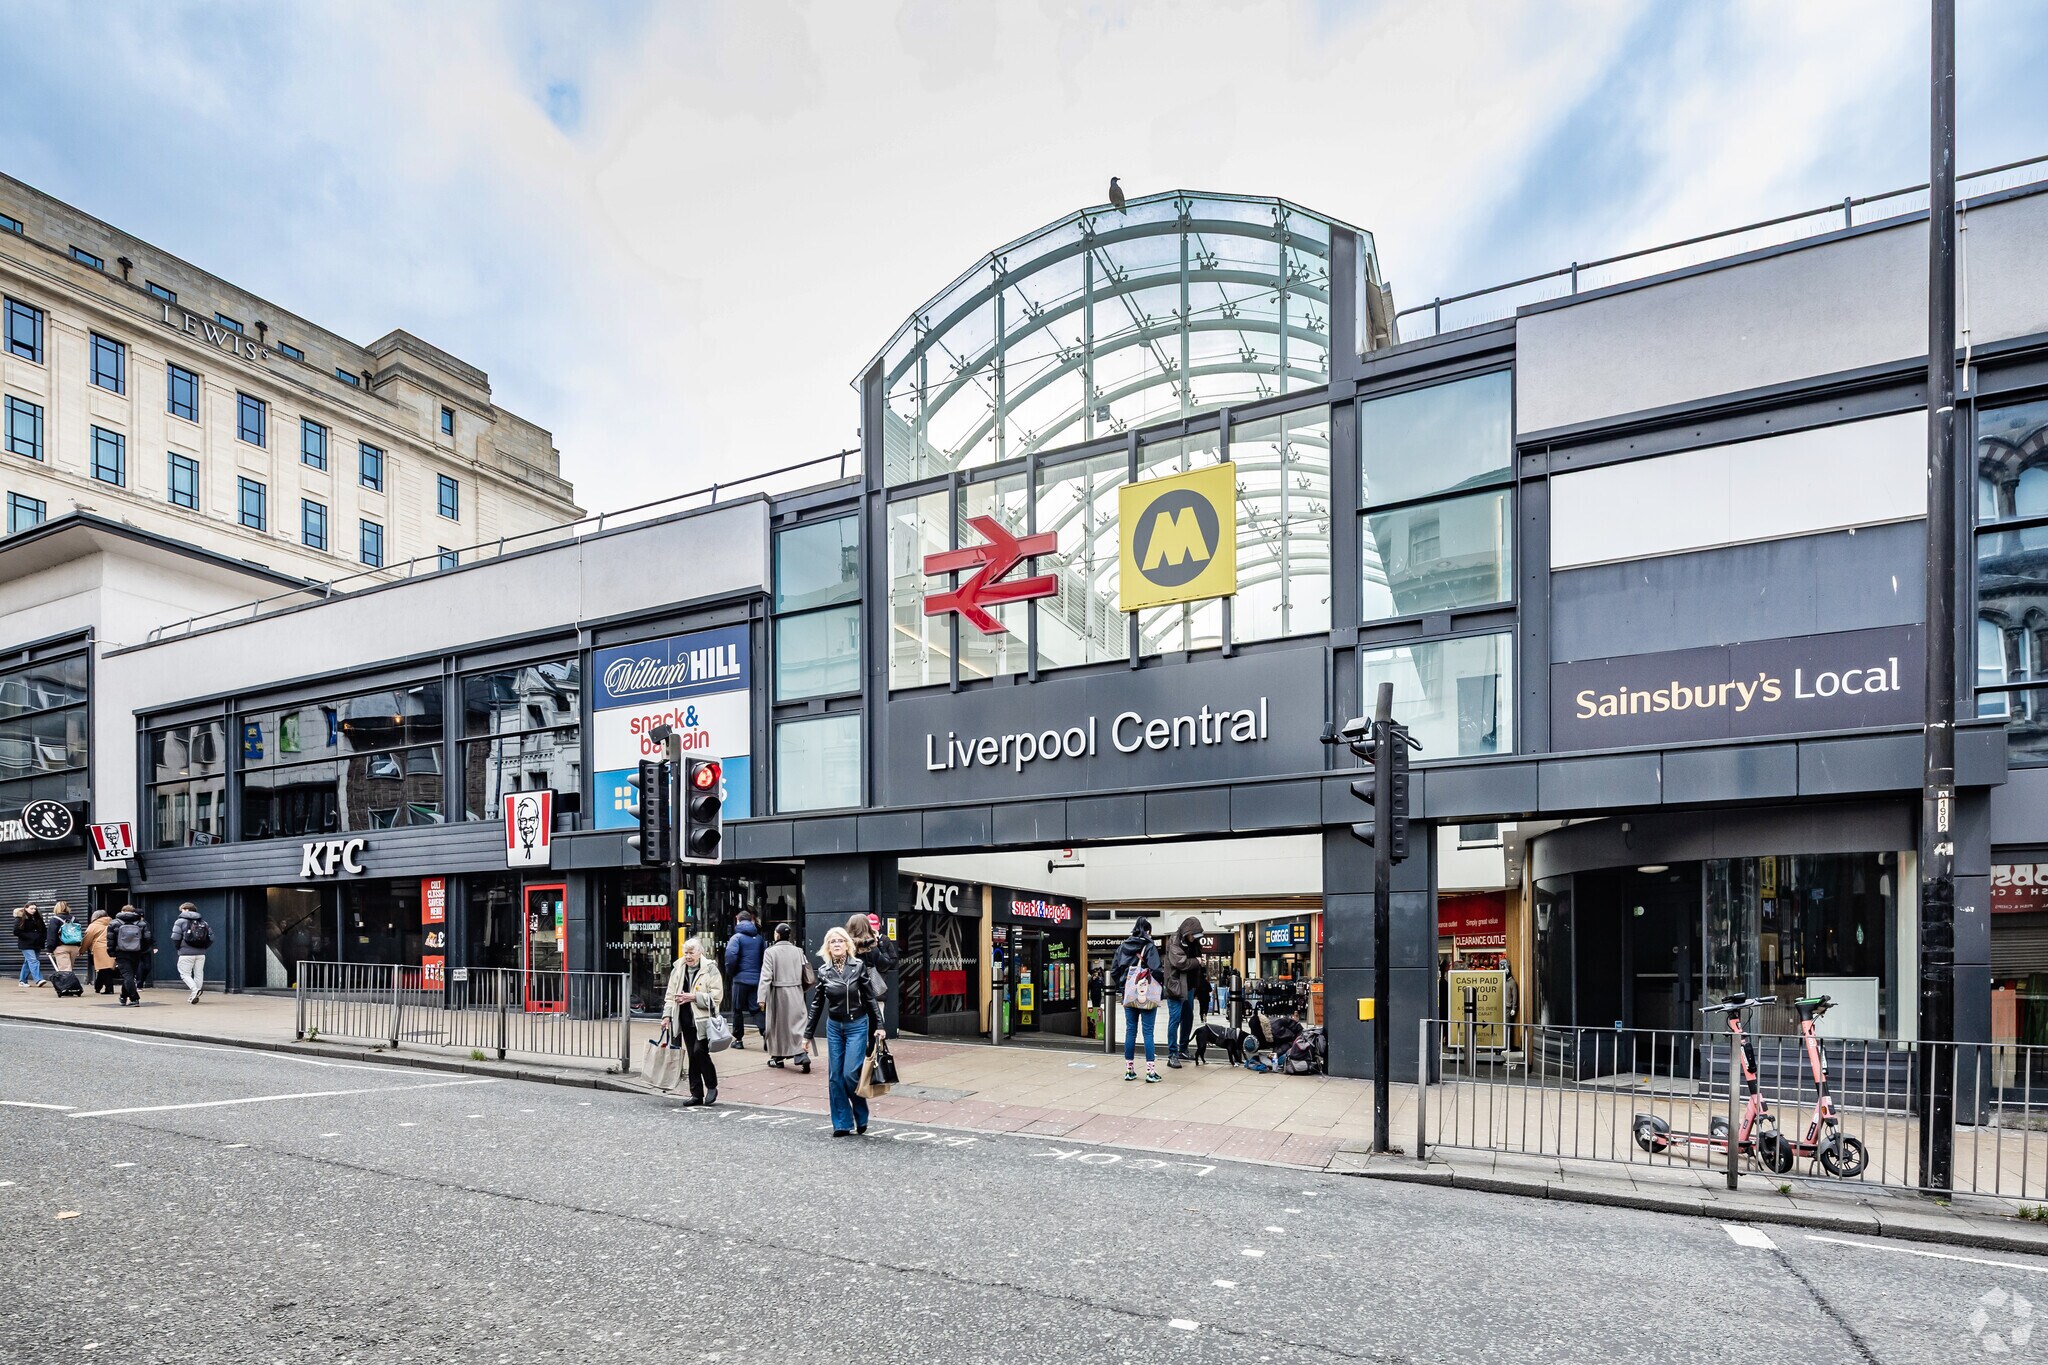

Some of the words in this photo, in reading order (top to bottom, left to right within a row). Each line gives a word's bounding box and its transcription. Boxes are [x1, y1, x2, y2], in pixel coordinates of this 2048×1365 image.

[1142, 506, 1211, 572] M
[604, 652, 690, 697] William
[690, 644, 740, 681] HILL
[1576, 673, 1782, 719] Sainsbury's
[1795, 657, 1901, 699] Local
[641, 728, 709, 755] baain
[926, 716, 1097, 772] Liverpool
[1112, 697, 1268, 752] Central
[105, 848, 129, 858] KFC
[300, 838, 364, 877] KFC
[627, 894, 668, 906] HELLO
[914, 880, 959, 913] KFC
[622, 905, 671, 922] LIVERPOOL
[1465, 919, 1477, 927] Simply
[1478, 919, 1487, 927] great
[1455, 936, 1487, 946] CLEARANCE
